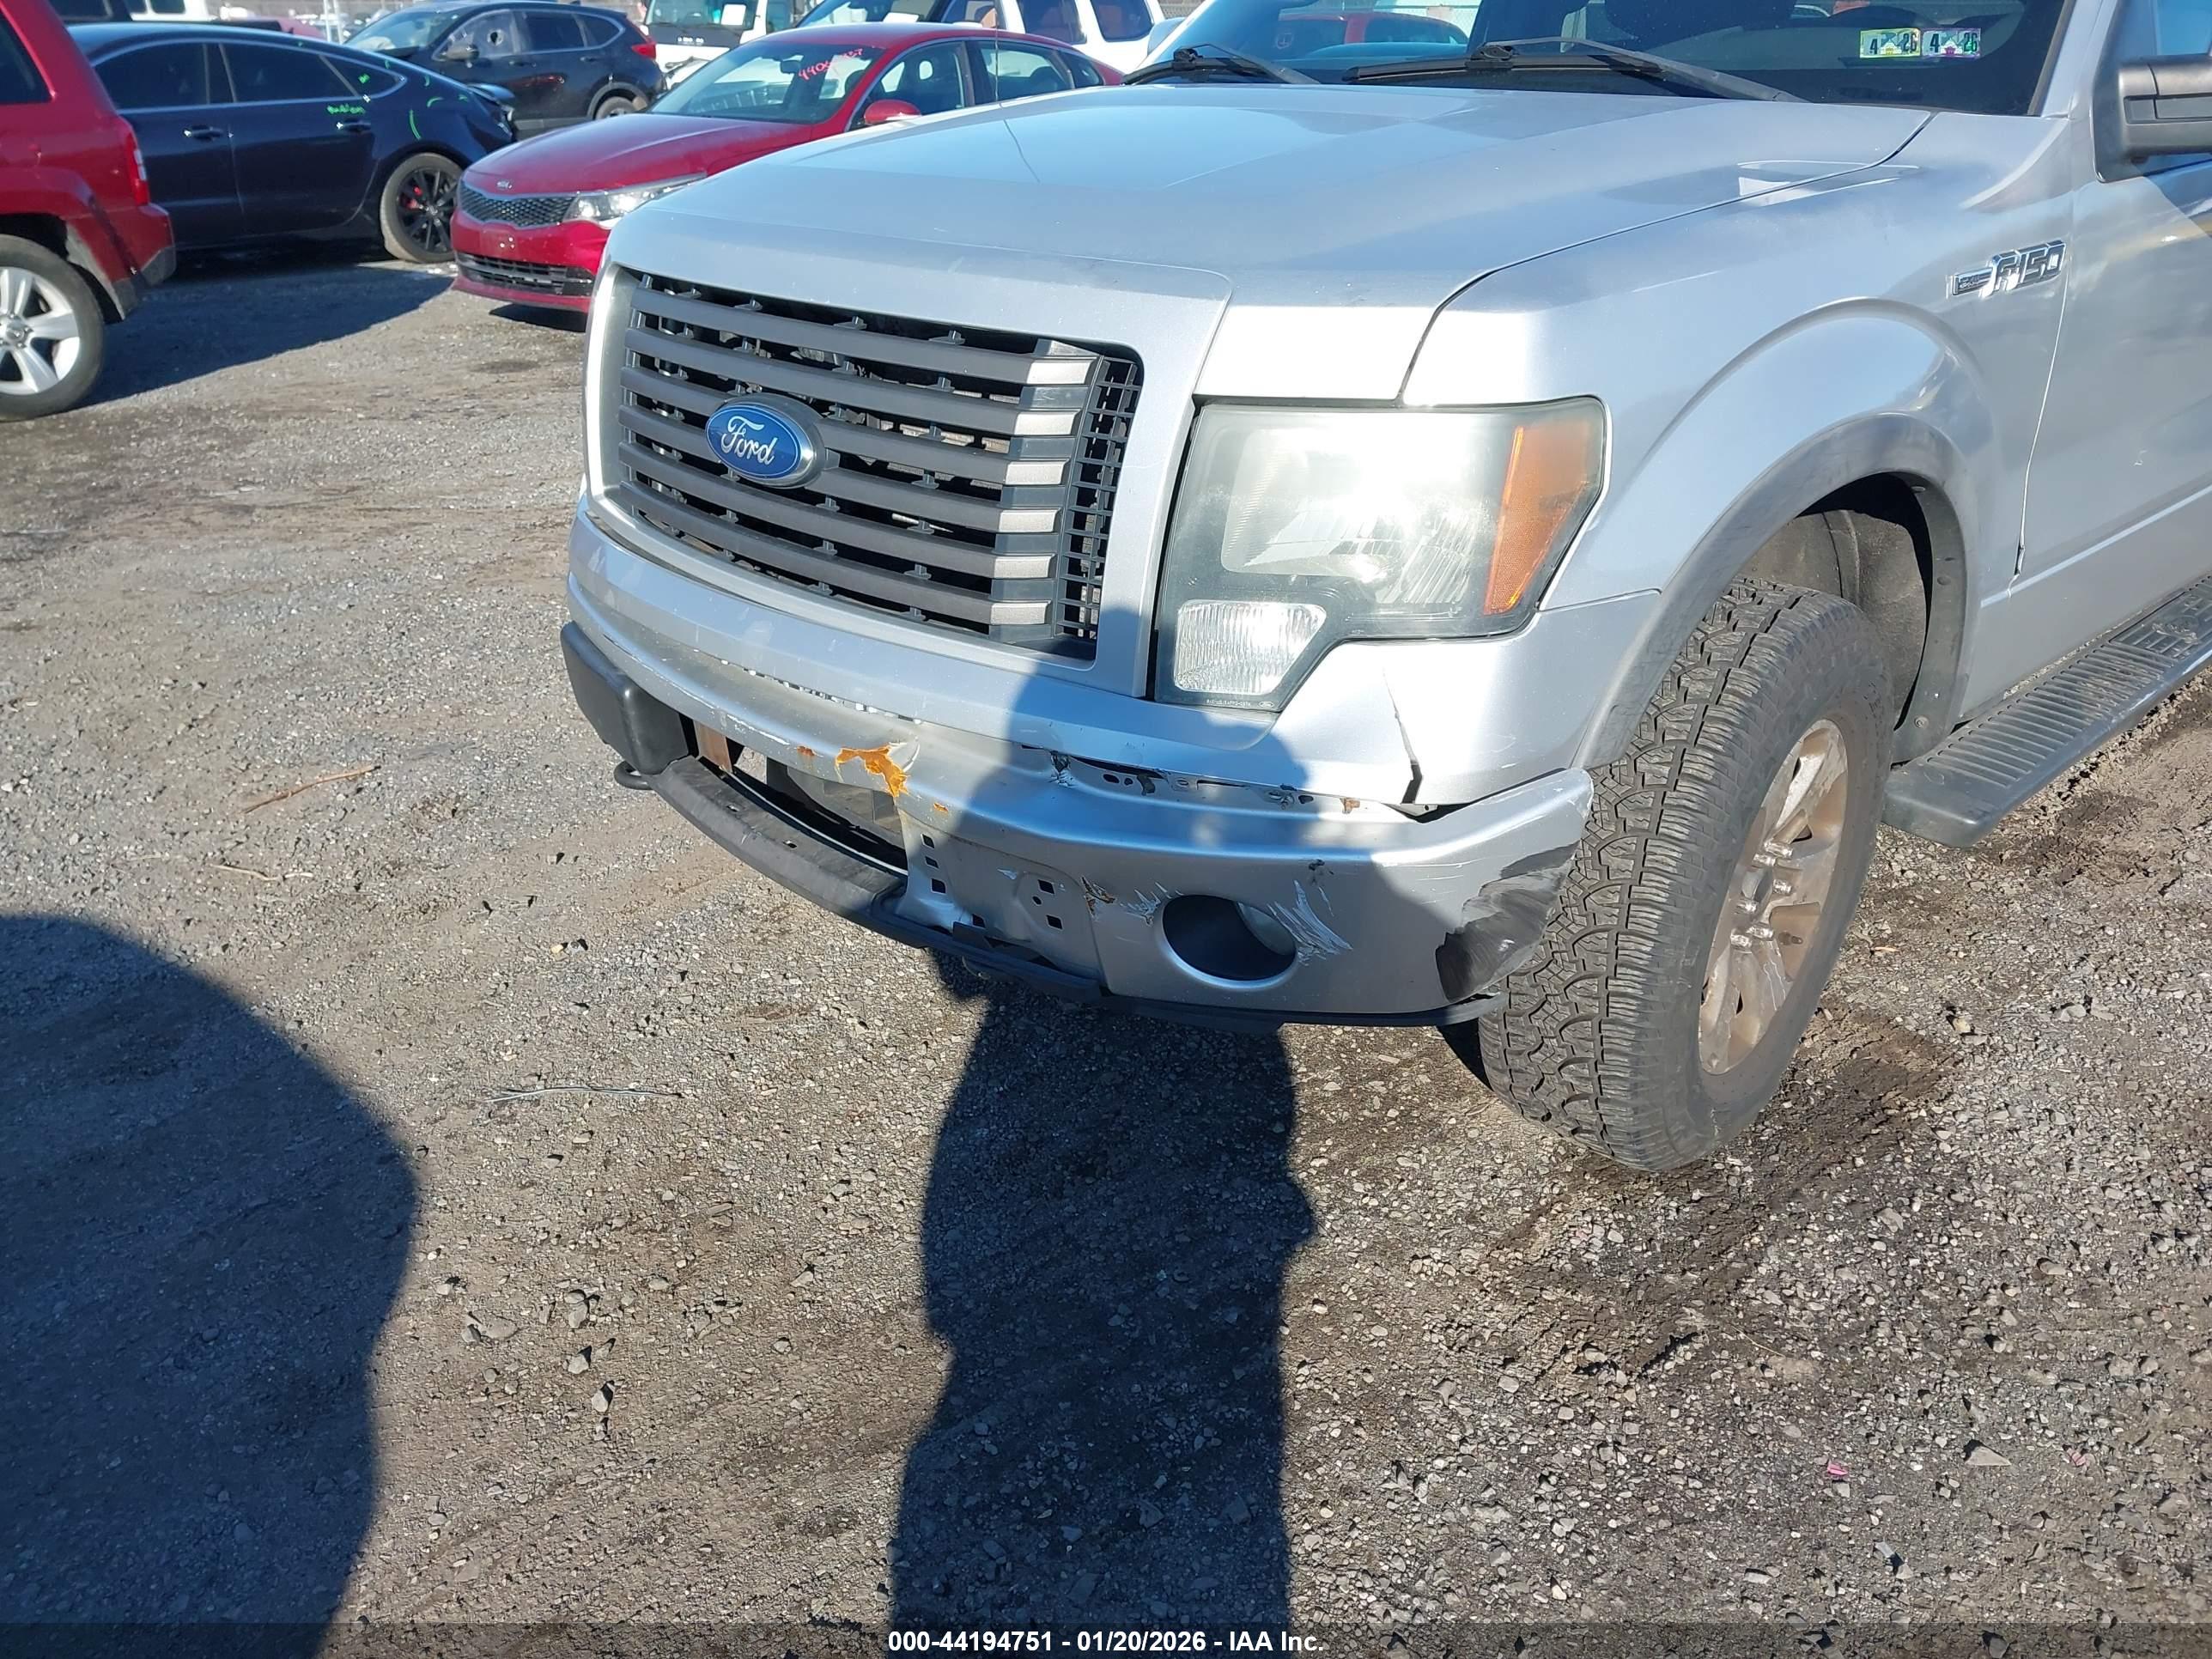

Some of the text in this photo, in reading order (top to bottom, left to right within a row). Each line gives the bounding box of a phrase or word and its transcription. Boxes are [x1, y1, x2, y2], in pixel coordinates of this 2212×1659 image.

[1869, 38, 1878, 55] 4
[1929, 32, 1978, 53] 4 26
[720, 415, 779, 465] Ford
